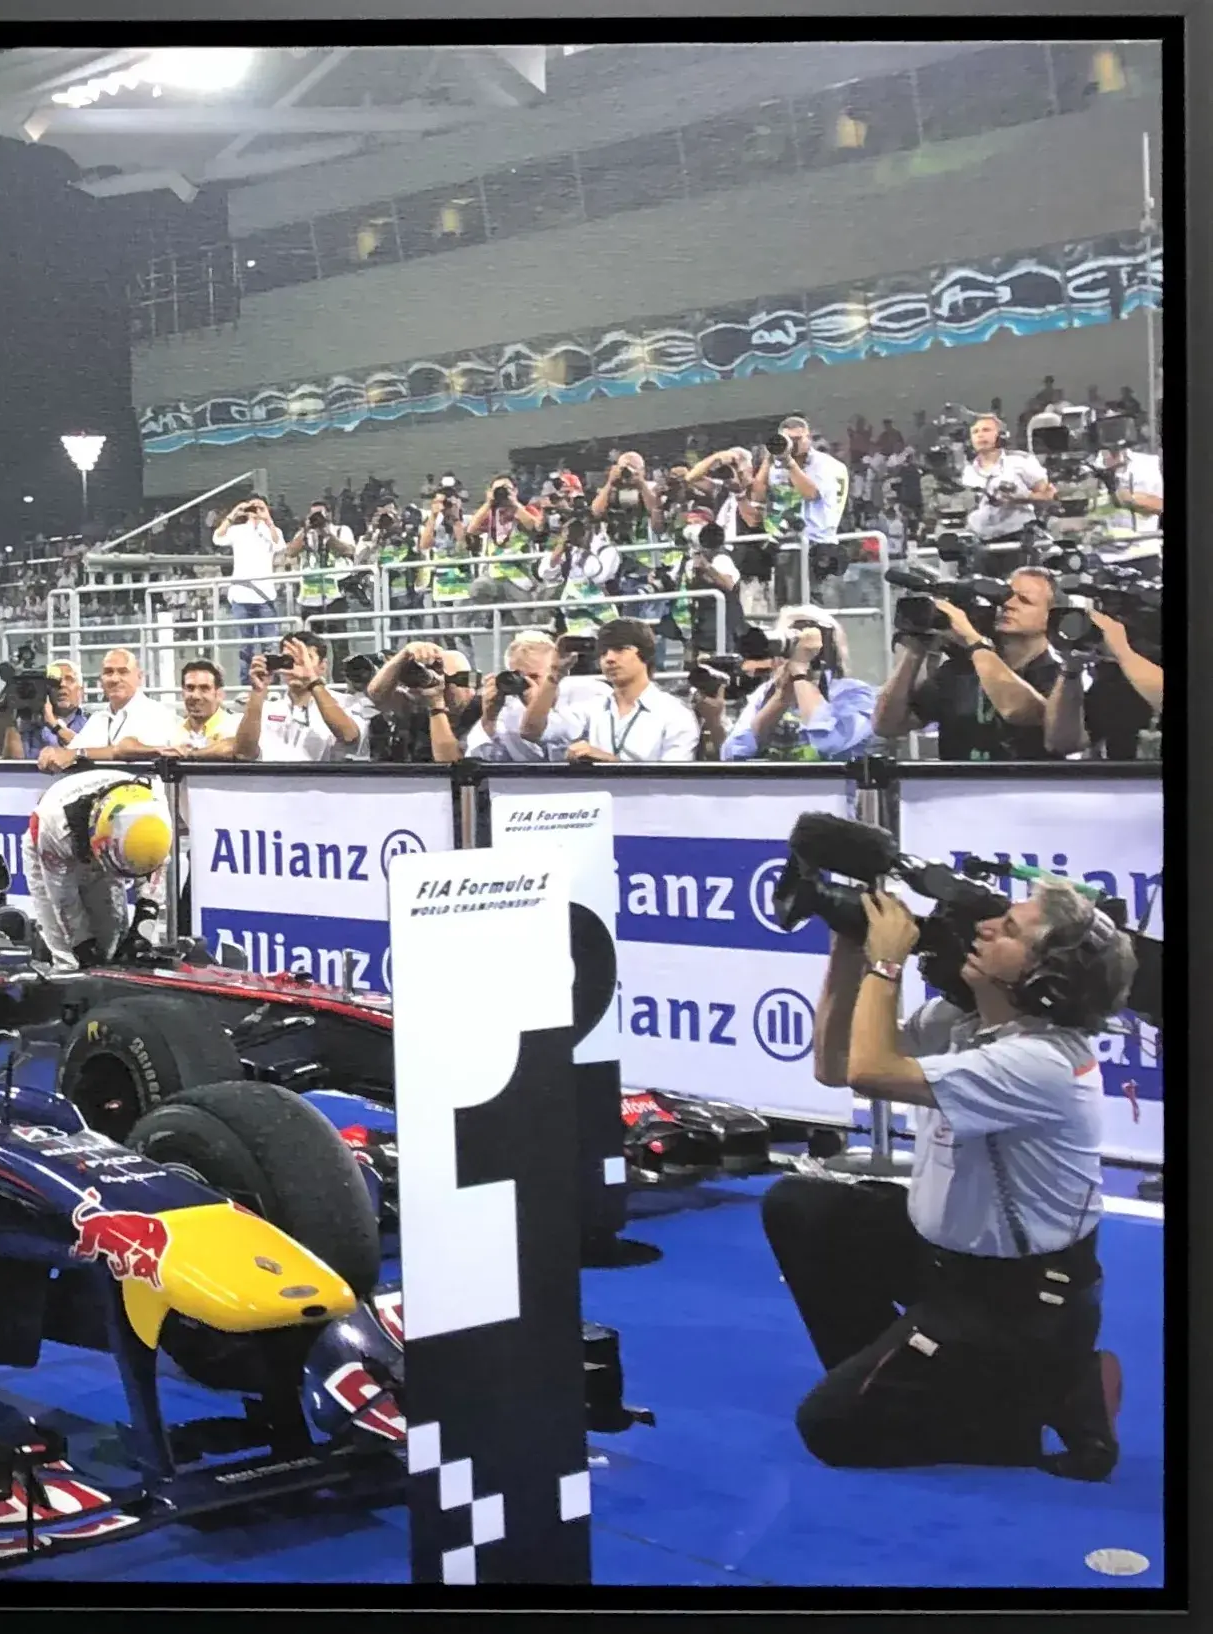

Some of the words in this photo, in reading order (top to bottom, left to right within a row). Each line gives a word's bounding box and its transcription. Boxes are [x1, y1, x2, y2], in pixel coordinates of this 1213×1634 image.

[210, 828, 369, 881] Allianz
[416, 879, 452, 900] FIA
[456, 874, 535, 897] Formula
[410, 904, 451, 917] WORLD
